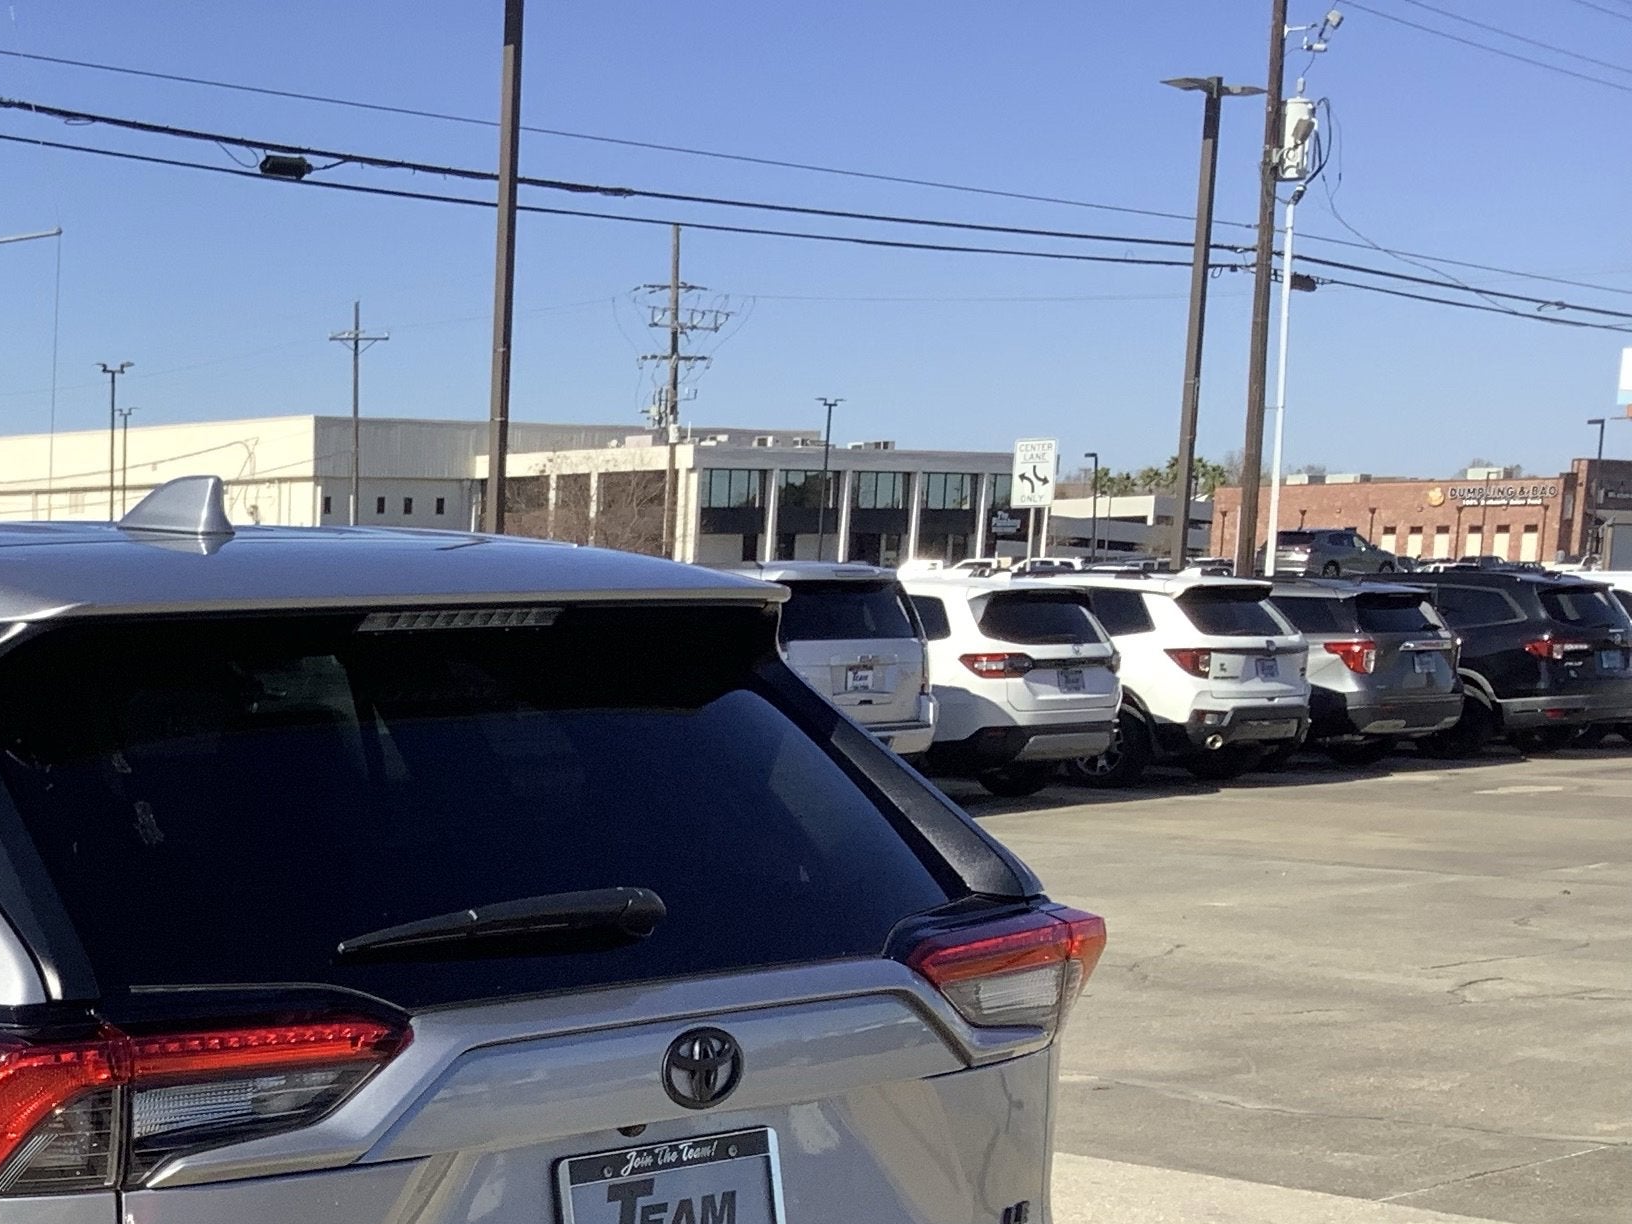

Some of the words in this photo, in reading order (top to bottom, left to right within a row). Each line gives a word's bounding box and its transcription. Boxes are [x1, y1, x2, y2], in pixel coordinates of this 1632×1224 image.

[1018, 442, 1054, 453] CENTER
[1023, 452, 1048, 462] LANE
[1449, 486, 1516, 498] DUMPLING
[1530, 485, 1559, 498] BAO
[1019, 494, 1044, 504] ONLY
[620, 1150, 654, 1177] Join
[654, 1146, 679, 1165] The
[679, 1140, 718, 1162] Team!
